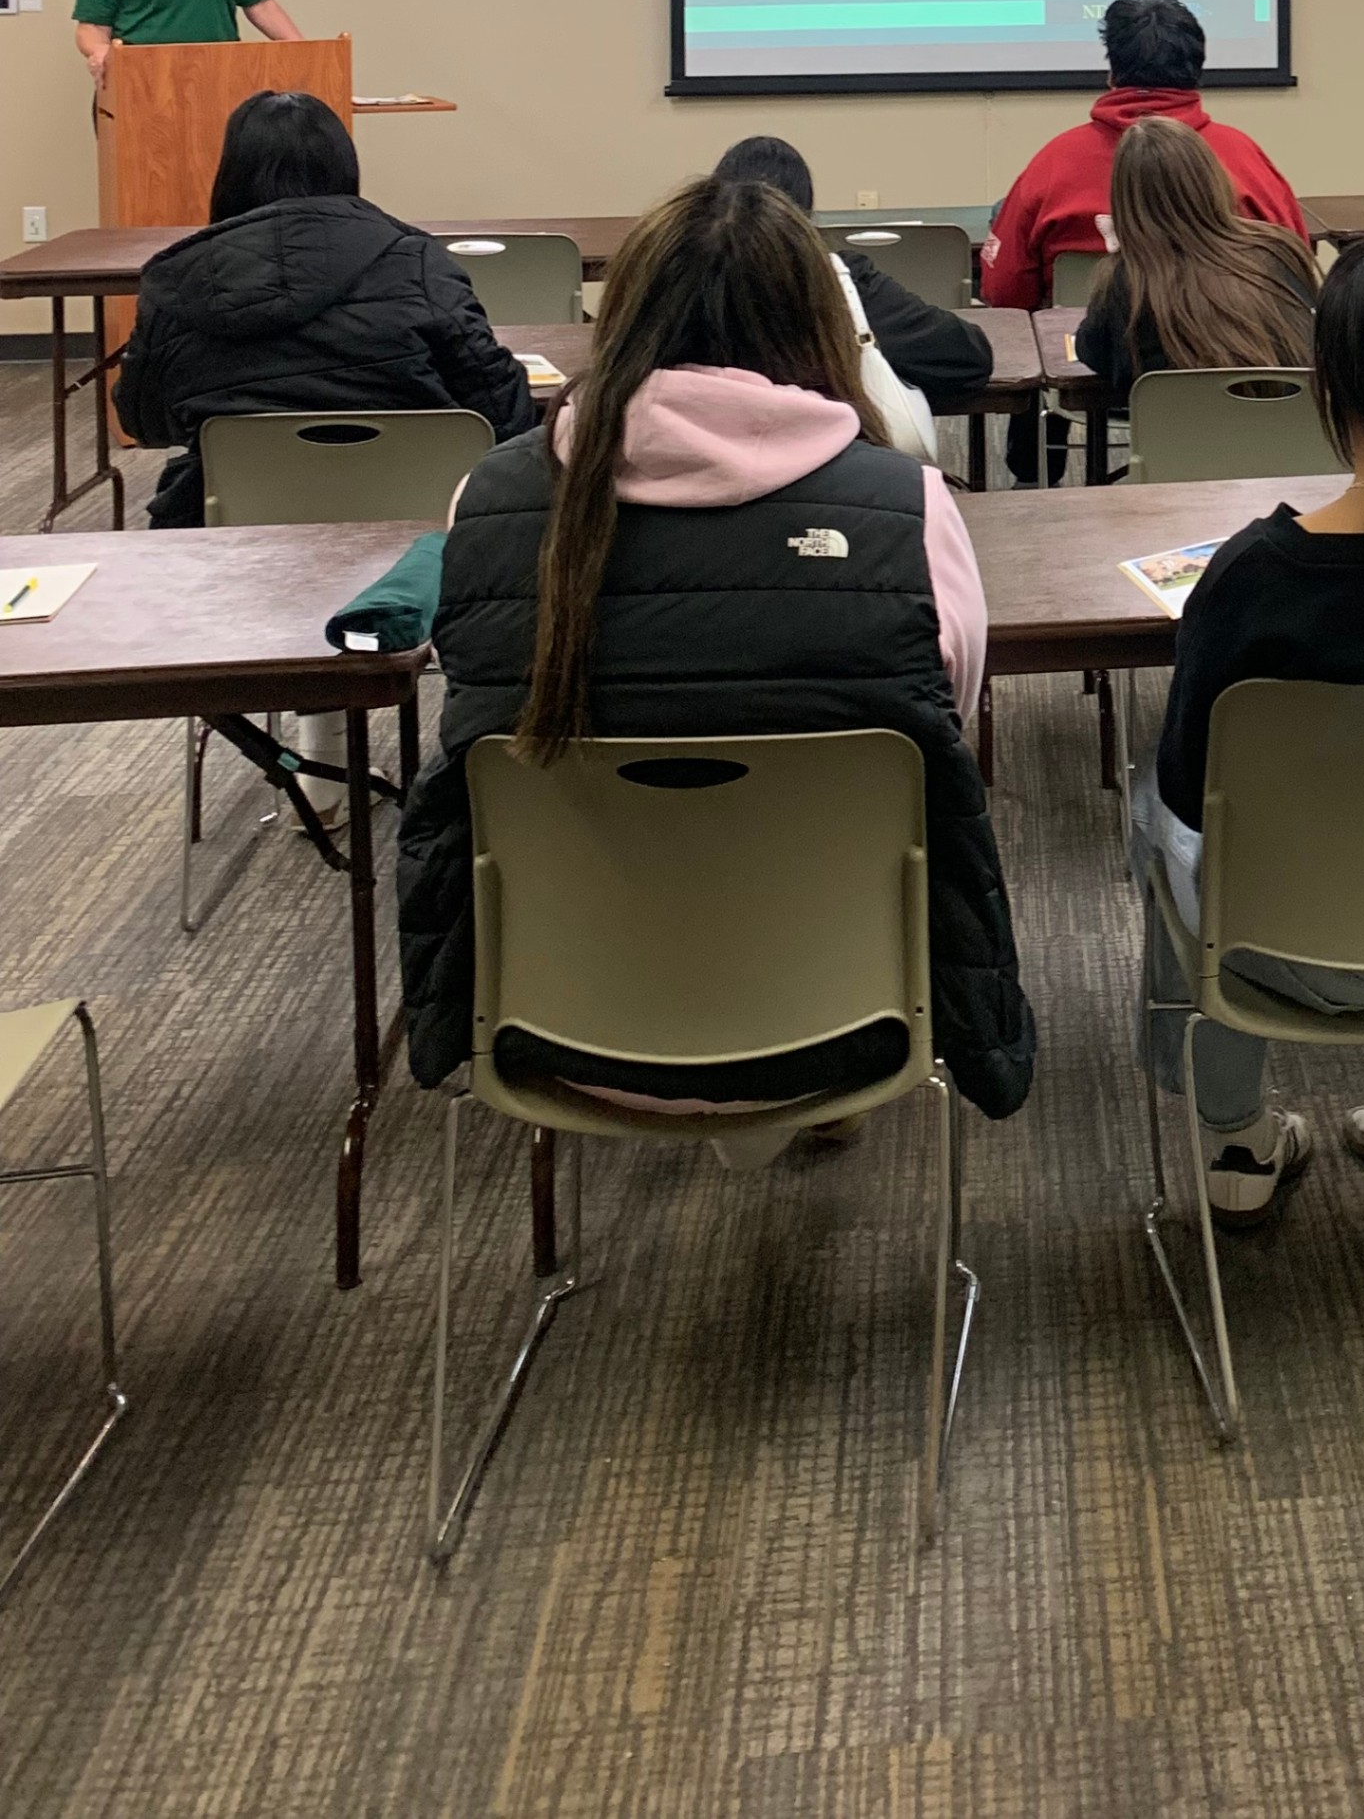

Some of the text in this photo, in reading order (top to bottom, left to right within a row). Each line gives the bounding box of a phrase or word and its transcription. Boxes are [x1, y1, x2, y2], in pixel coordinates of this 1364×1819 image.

[805, 528, 829, 538] THE
[787, 537, 828, 548] NORTH
[798, 546, 829, 557] FACE
